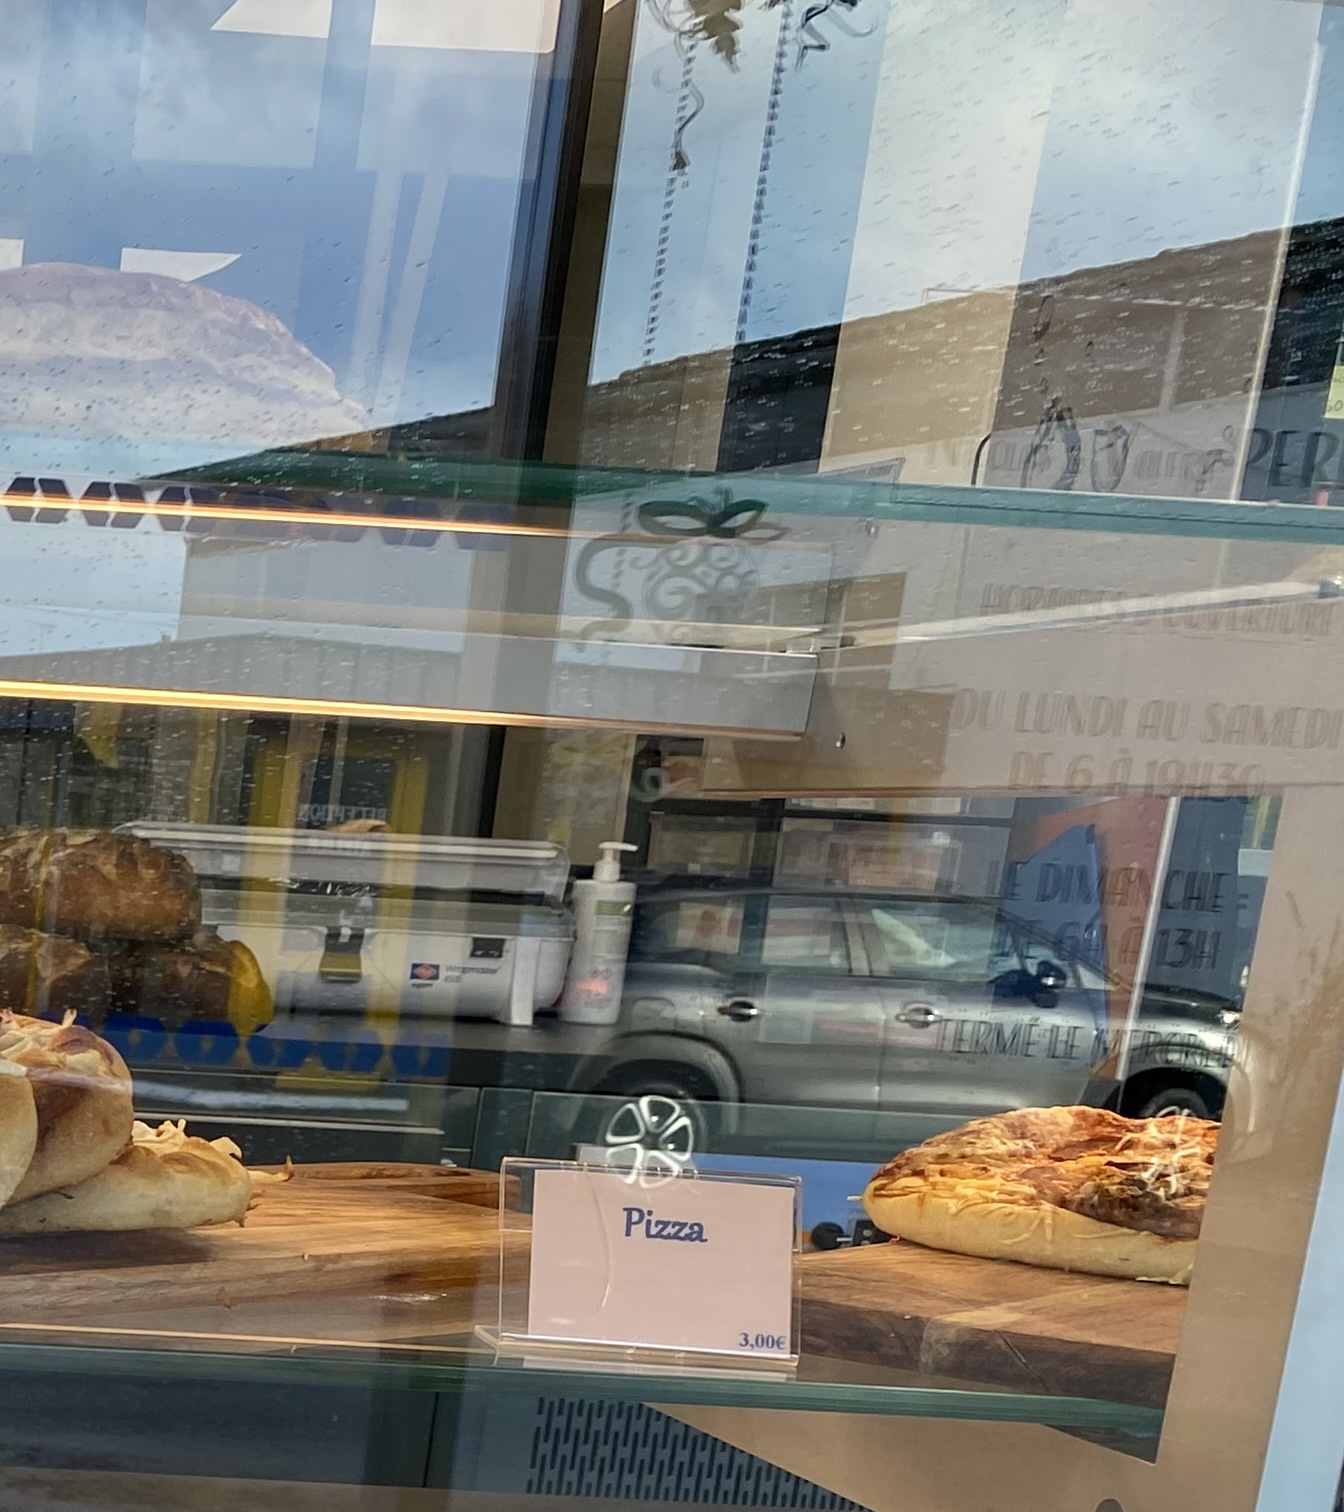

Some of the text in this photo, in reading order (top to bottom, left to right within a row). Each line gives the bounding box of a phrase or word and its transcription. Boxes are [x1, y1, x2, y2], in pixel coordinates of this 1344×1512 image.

[952, 687, 1344, 751] DU LUNDI AU SAMEDI
[1036, 861, 1232, 913] DIMANCHE
[1154, 927, 1222, 972] 13H
[623, 1206, 708, 1243] Pizza
[738, 1332, 787, 1351] 3,00€
